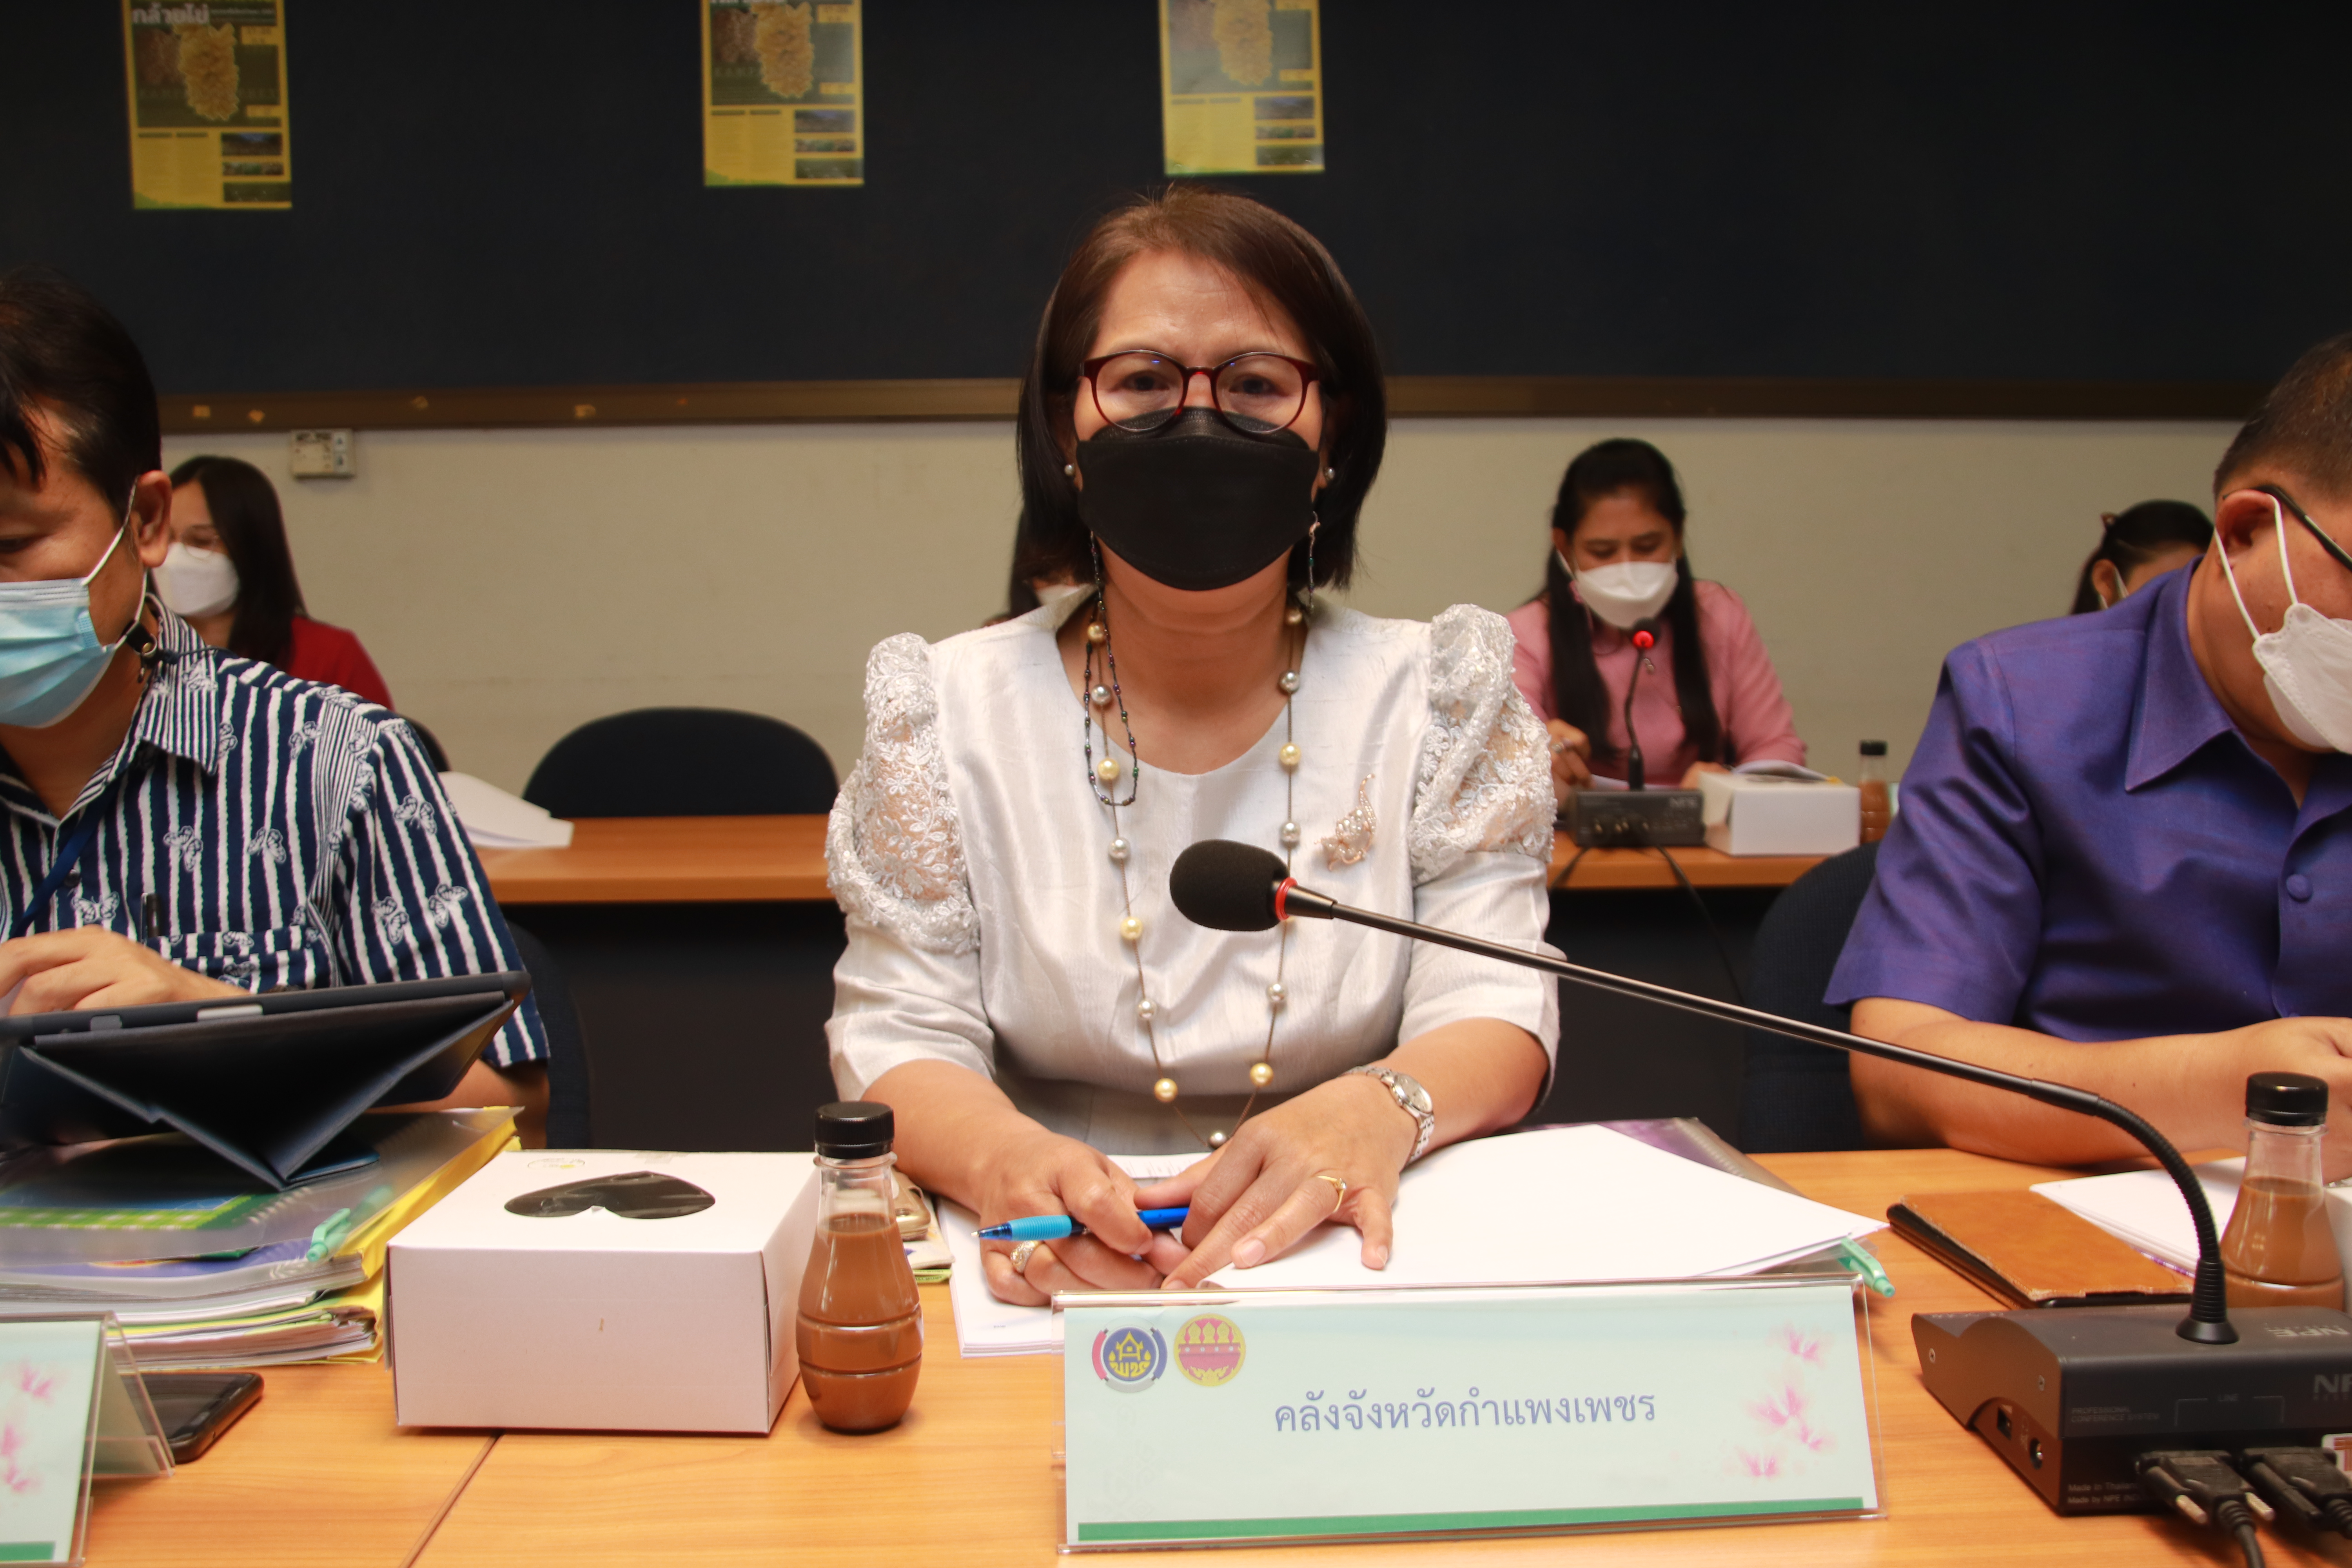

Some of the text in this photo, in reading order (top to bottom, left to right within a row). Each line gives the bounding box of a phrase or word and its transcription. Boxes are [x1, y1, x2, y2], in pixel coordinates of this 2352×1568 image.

[1274, 1386, 1656, 1432] คลังจังหวัดกำแพงเพชร
